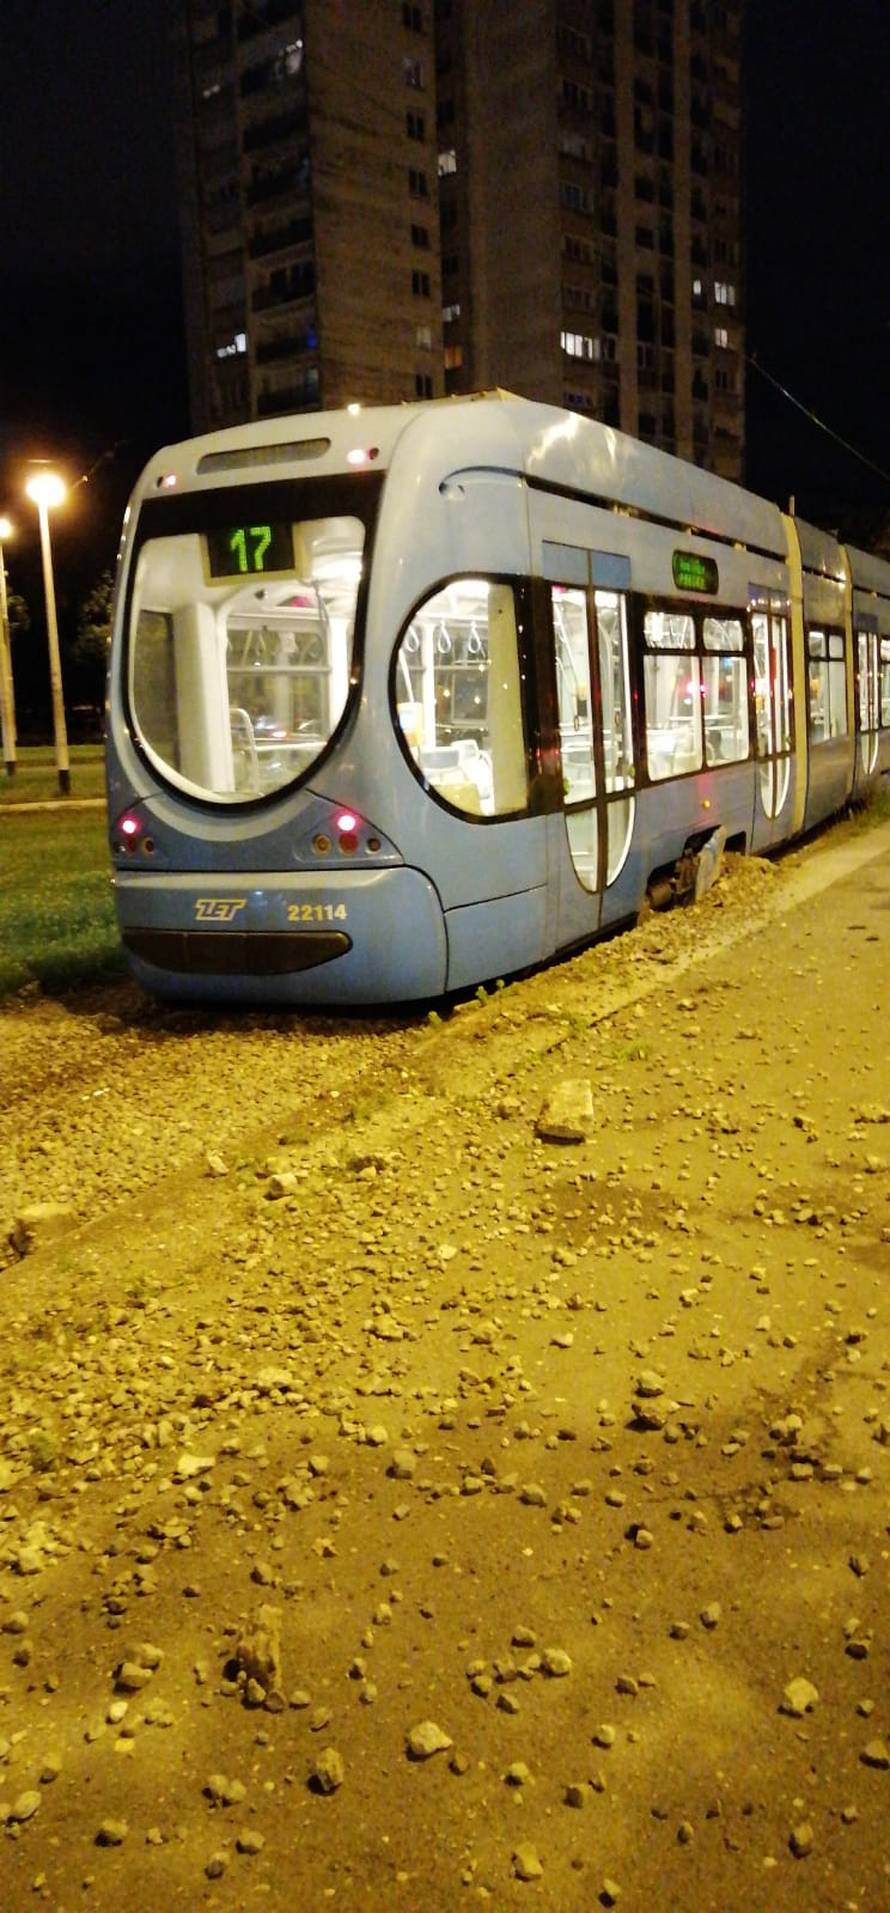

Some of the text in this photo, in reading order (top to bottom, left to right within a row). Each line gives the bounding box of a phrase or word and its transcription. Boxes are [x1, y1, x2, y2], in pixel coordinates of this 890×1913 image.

[230, 526, 271, 572] 17
[195, 899, 246, 921] ZET
[287, 904, 348, 922] 22114
